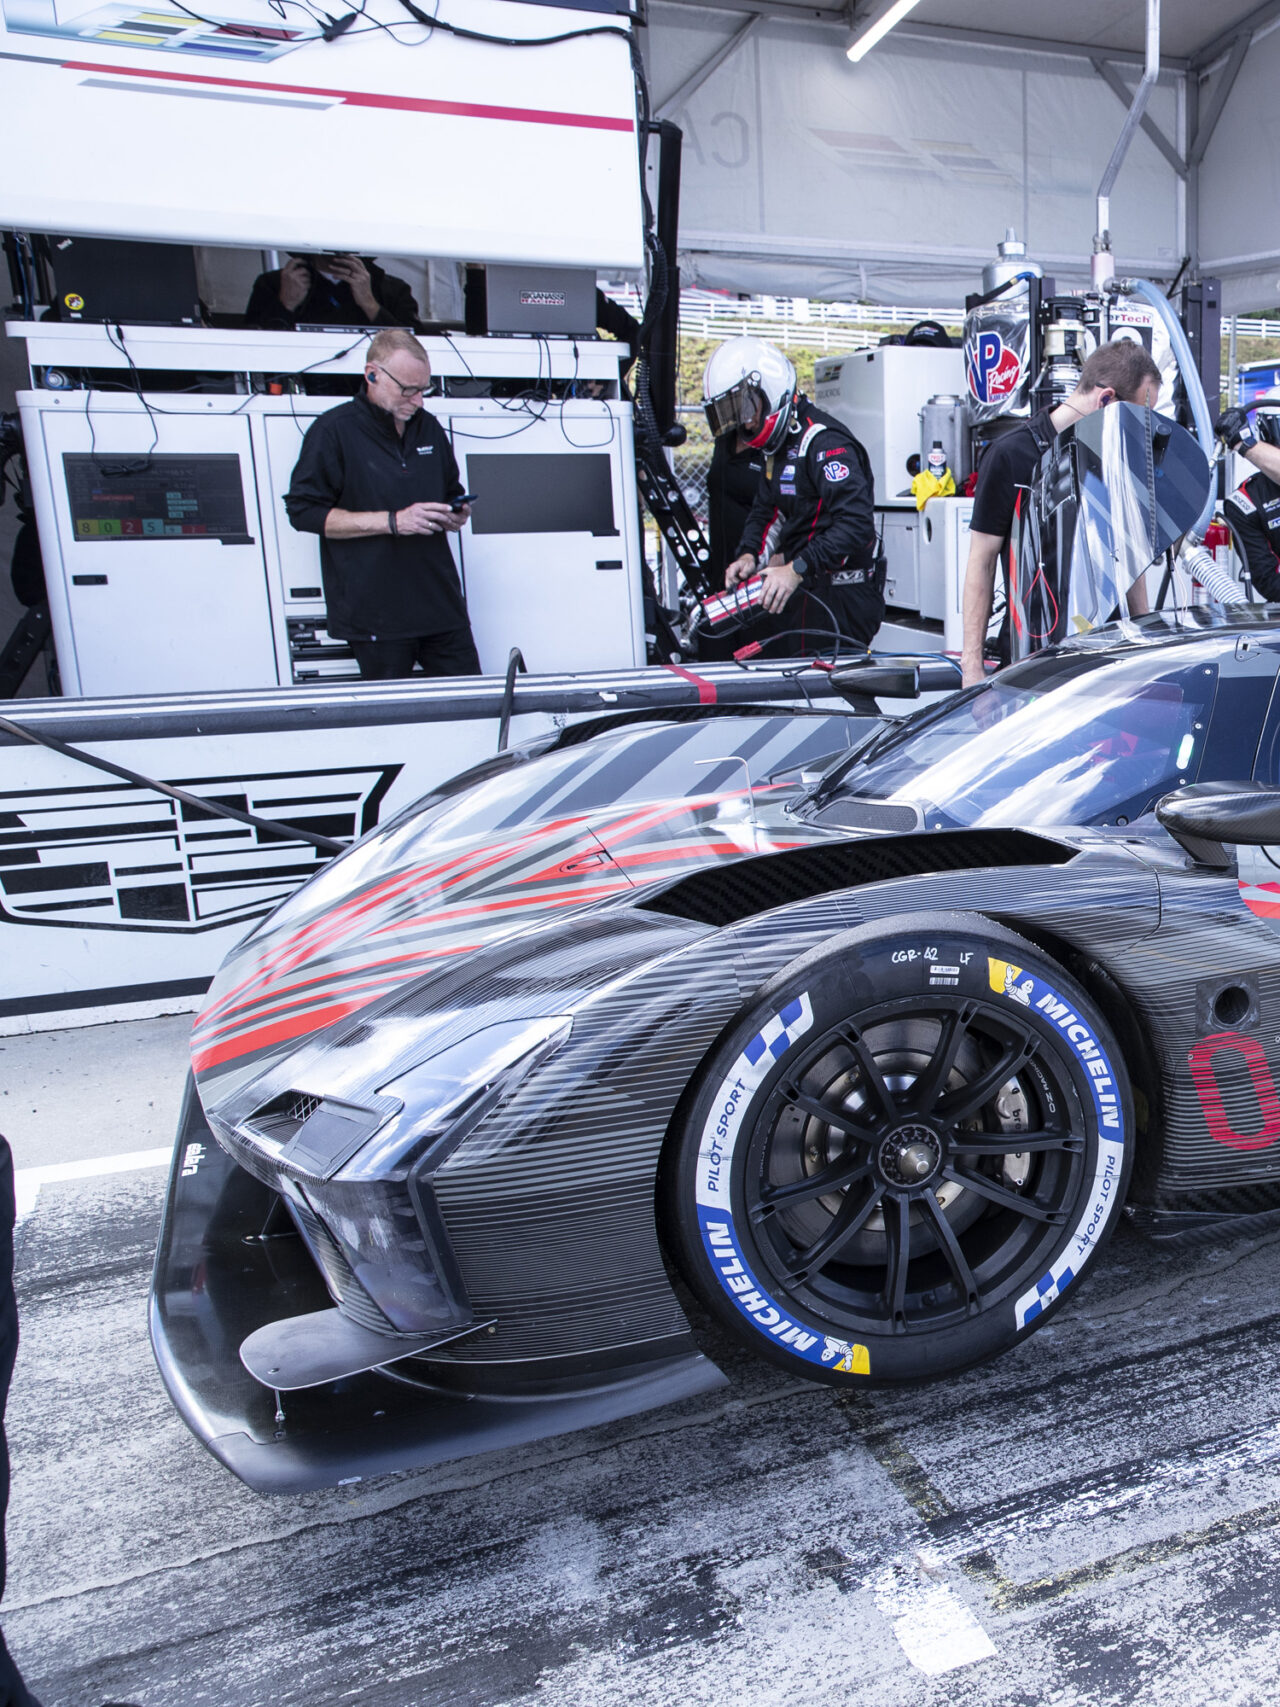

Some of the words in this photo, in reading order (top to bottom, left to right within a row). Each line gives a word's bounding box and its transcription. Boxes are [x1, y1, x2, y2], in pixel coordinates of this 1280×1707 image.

[965, 331, 1003, 404] VP
[989, 365, 1020, 393] Racing
[126, 522, 135, 533] 2
[960, 952, 974, 965] LF
[1035, 993, 1120, 1129] MICHELIN
[708, 1140, 723, 1192] PILOT
[717, 1078, 746, 1138] SPORT
[1100, 1154, 1116, 1202] PILOT
[1077, 1203, 1104, 1256] SPORT
[706, 1221, 818, 1352] MICHELIN
